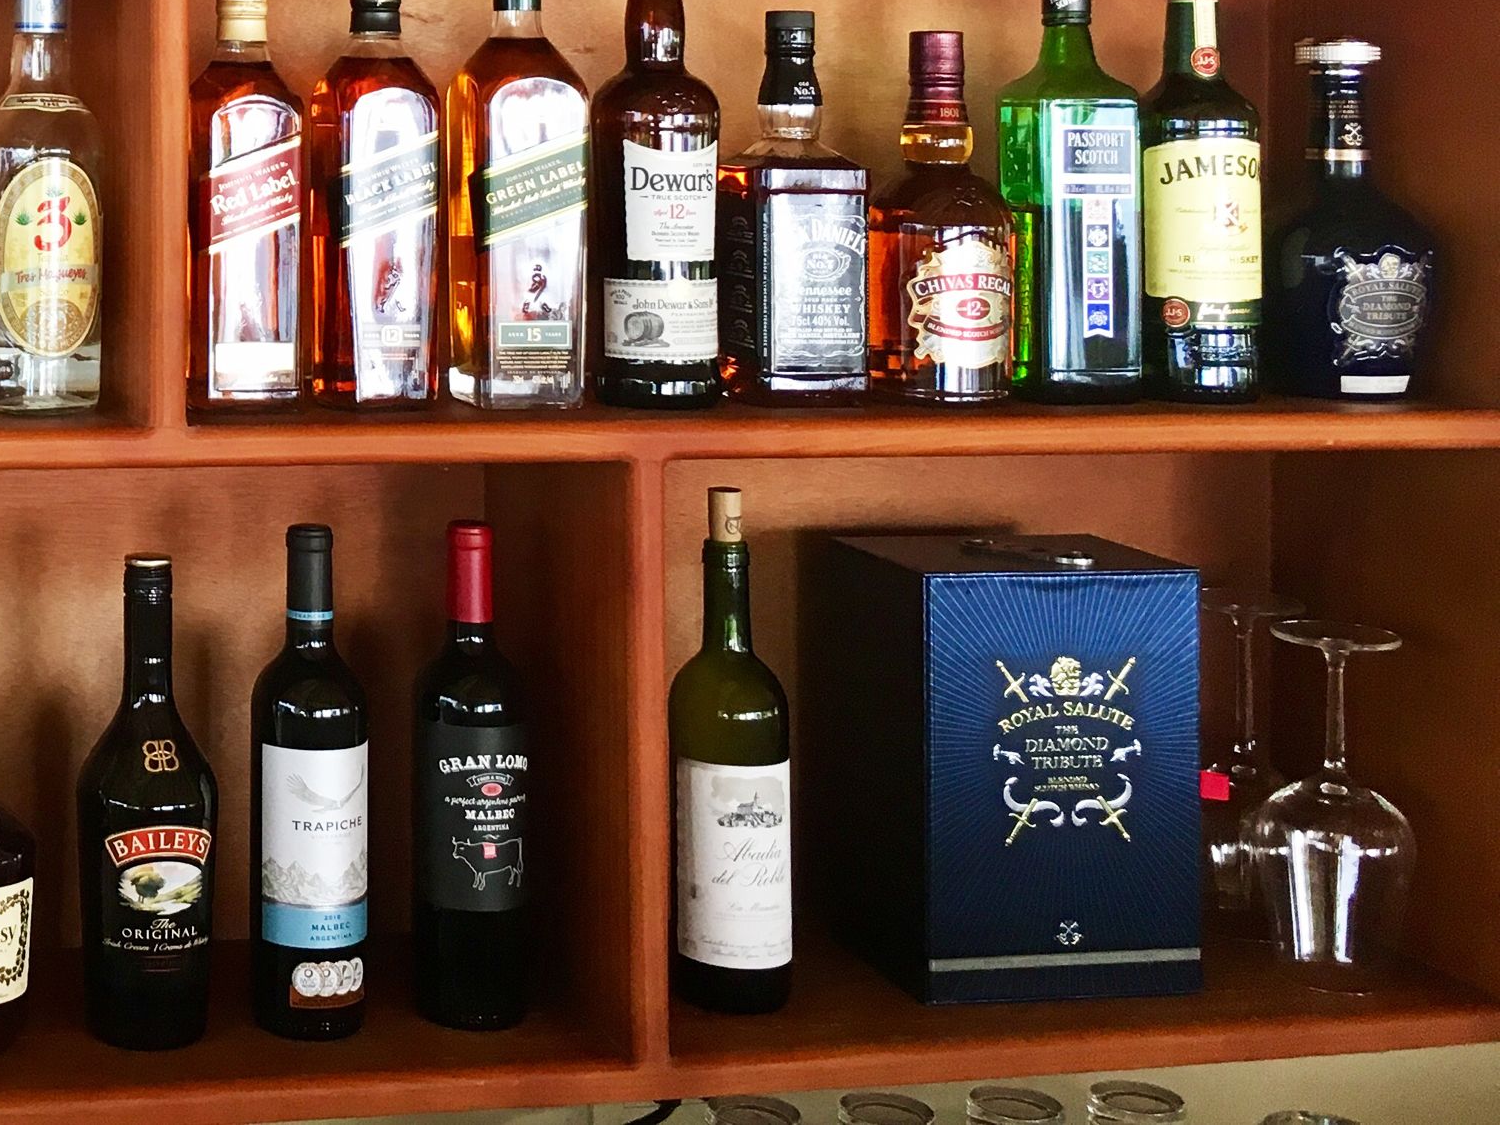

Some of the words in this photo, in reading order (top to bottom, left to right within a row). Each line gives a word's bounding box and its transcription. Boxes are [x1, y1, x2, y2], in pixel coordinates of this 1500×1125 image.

[940, 106, 959, 118] 1801
[1067, 132, 1125, 148] PASSPORT
[1075, 149, 1118, 165] SCOTCH
[395, 162, 438, 188] LABEL
[486, 177, 537, 205] GREEN
[539, 160, 586, 186] LABEL
[630, 166, 714, 192] Dewar's
[210, 187, 250, 215] Red
[250, 168, 298, 200] Label
[669, 203, 685, 220] 12
[34, 195, 72, 252] 3
[15, 270, 36, 284] Tres
[797, 286, 853, 296] ennessee
[915, 275, 974, 296] CHIVAS
[978, 275, 1012, 297] REGAL
[1351, 282, 1386, 296] ROYAL
[632, 298, 656, 310] John
[657, 299, 687, 310] Dewar
[967, 300, 982, 316] 12
[1362, 302, 1412, 311] DIAMOND
[384, 328, 399, 342] 12
[526, 327, 542, 342] 15
[998, 703, 1059, 735] ROYAL
[1063, 701, 1136, 731] SALUTE
[1055, 725, 1079, 735] THE
[1025, 736, 1109, 753] DIAMOND
[439, 754, 492, 775] GRAN
[495, 754, 528, 771] LOMO
[1031, 755, 1104, 770] TRIBUTE
[465, 808, 515, 821] MALBEC
[292, 818, 363, 832] TRAPICHE
[113, 832, 210, 858] BAILEYS
[712, 869, 735, 885] del
[150, 918, 177, 930] The
[311, 921, 351, 931] MALBEC
[121, 925, 198, 940] ORIGINAL
[310, 932, 352, 941] ARGENTINA
